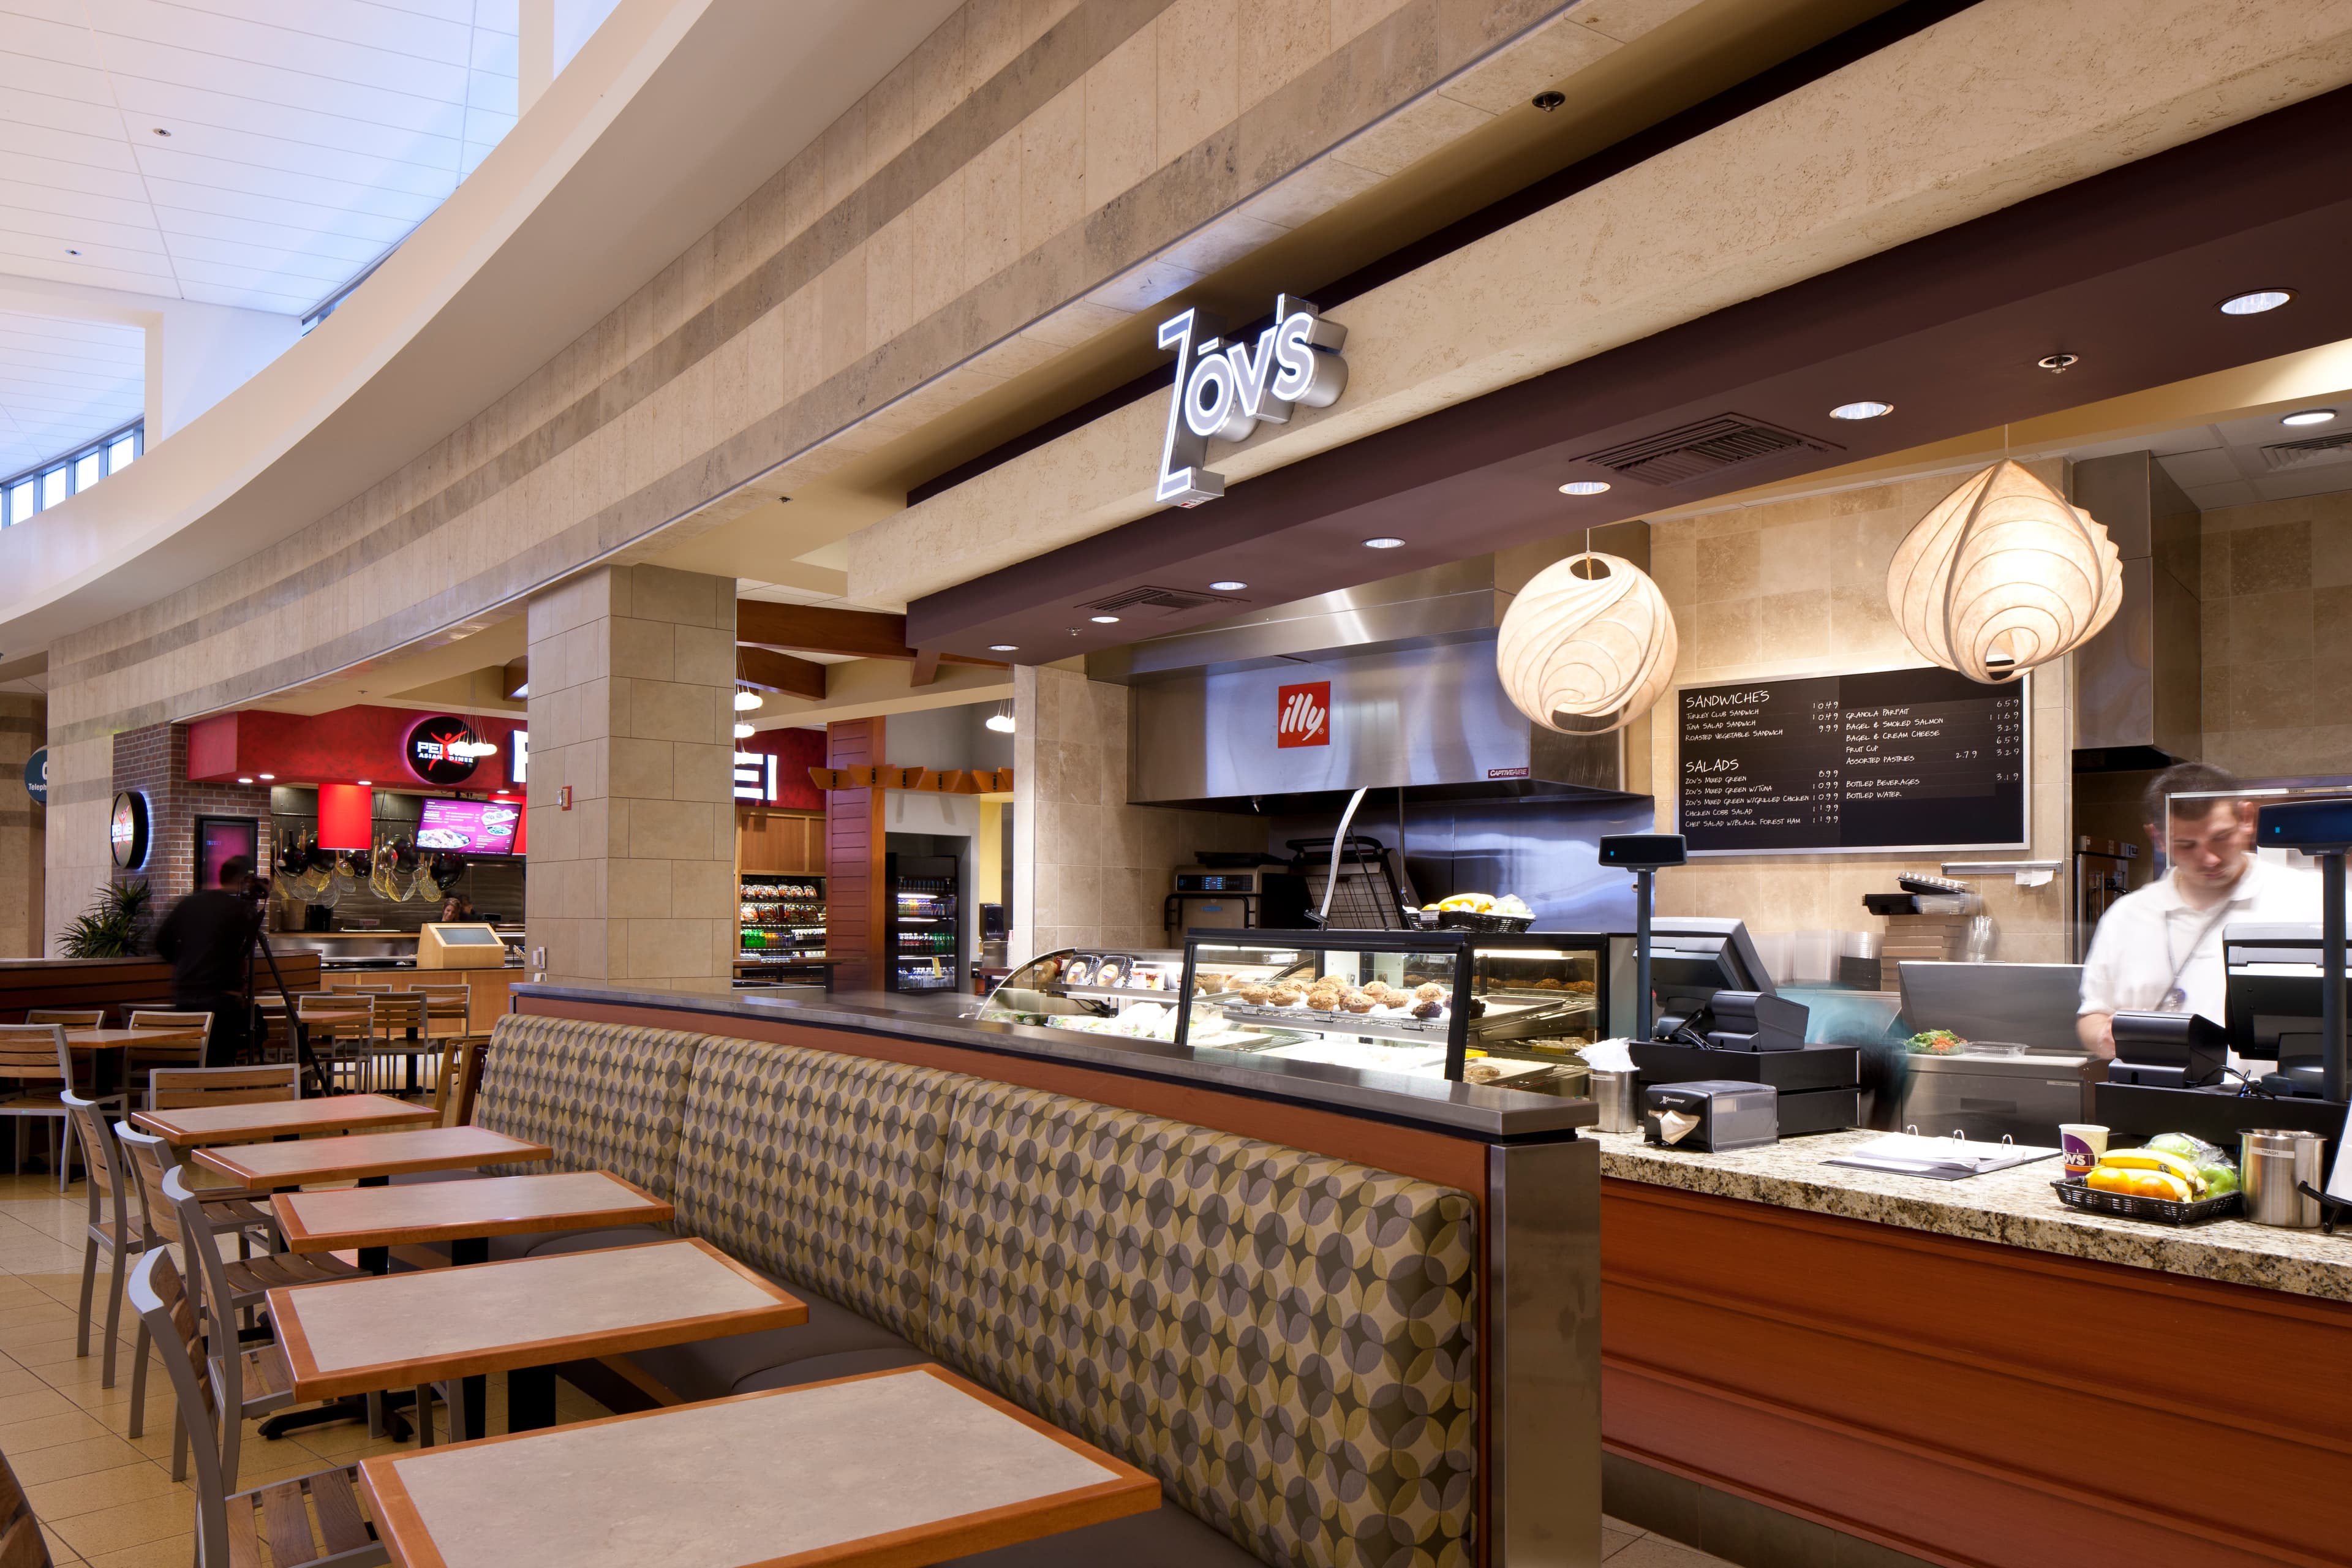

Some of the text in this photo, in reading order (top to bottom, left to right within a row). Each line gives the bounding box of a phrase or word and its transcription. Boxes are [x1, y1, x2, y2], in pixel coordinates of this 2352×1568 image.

[1686, 690, 1770, 709] SANDWICHES
[1280, 693, 1325, 741] illy
[1845, 710, 1879, 720] GRANOLA
[1715, 731, 1751, 741] VEGETABLE
[1686, 758, 1740, 773] SALADS
[1725, 775, 1747, 784] GREEN
[28, 783, 47, 792] Teleph
[1725, 786, 1747, 795] GREEN
[1724, 797, 1745, 806] GREEN
